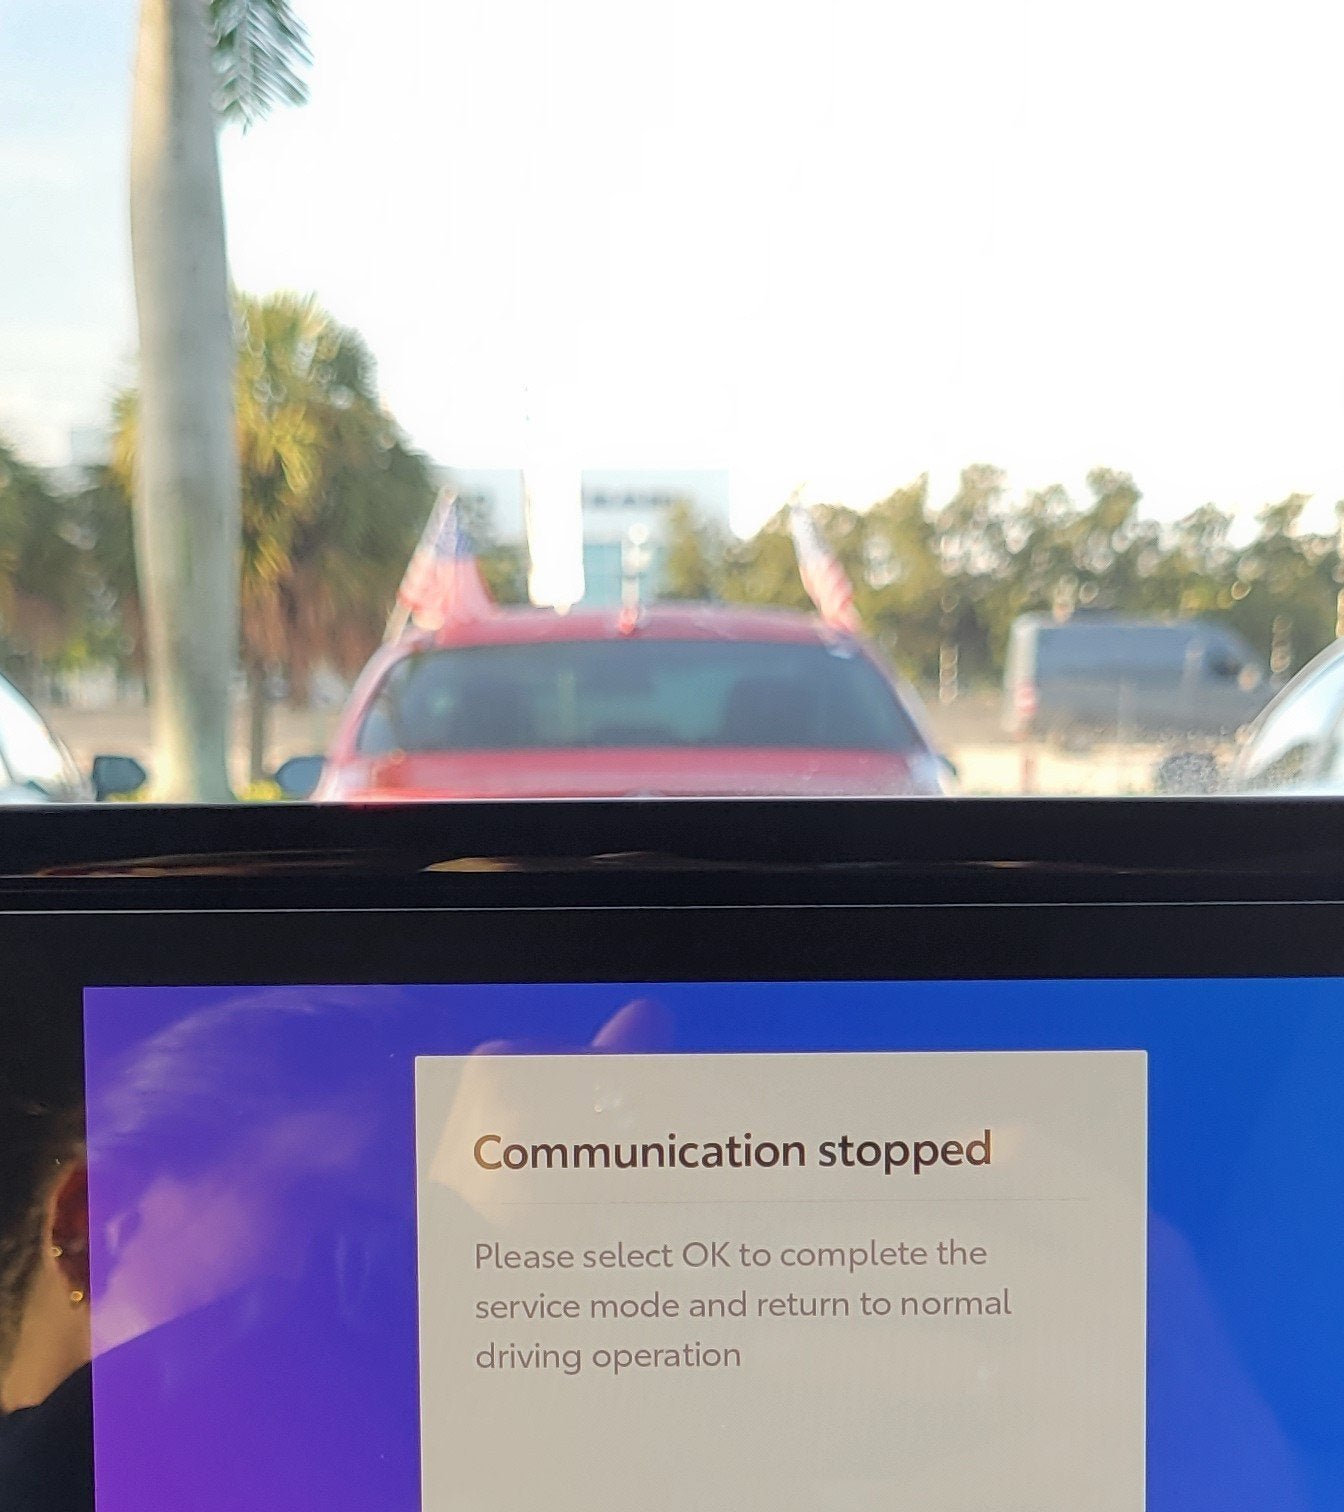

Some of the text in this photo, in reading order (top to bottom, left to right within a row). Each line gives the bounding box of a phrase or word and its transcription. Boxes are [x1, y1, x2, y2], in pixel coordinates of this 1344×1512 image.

[473, 1128, 992, 1175] Communication stopped
[475, 1238, 988, 1274] Please select OK to complete the
[475, 1287, 1013, 1319] service mode and return to normal
[476, 1340, 742, 1376] driving operation
